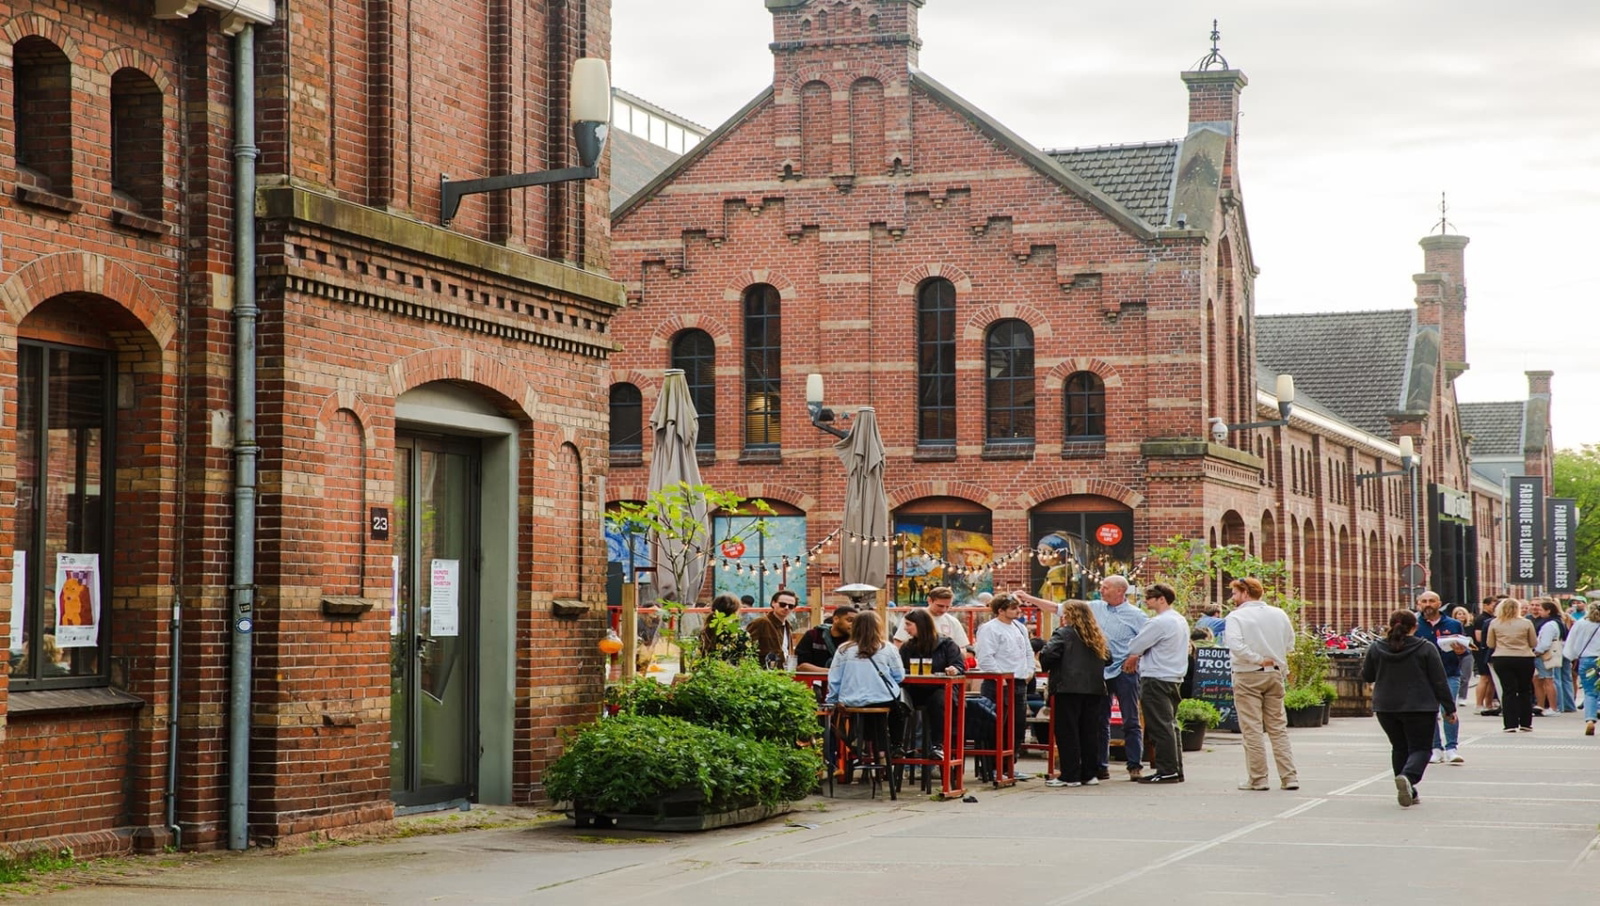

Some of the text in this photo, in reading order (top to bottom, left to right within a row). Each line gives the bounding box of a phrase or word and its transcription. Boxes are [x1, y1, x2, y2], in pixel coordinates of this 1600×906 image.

[373, 516, 388, 531] 23
[1519, 484, 1535, 578] FABRIQUE DES LUMIÈRES
[1554, 505, 1567, 540] FABRIQUE
[1555, 553, 1569, 588] LUMIÈRES
